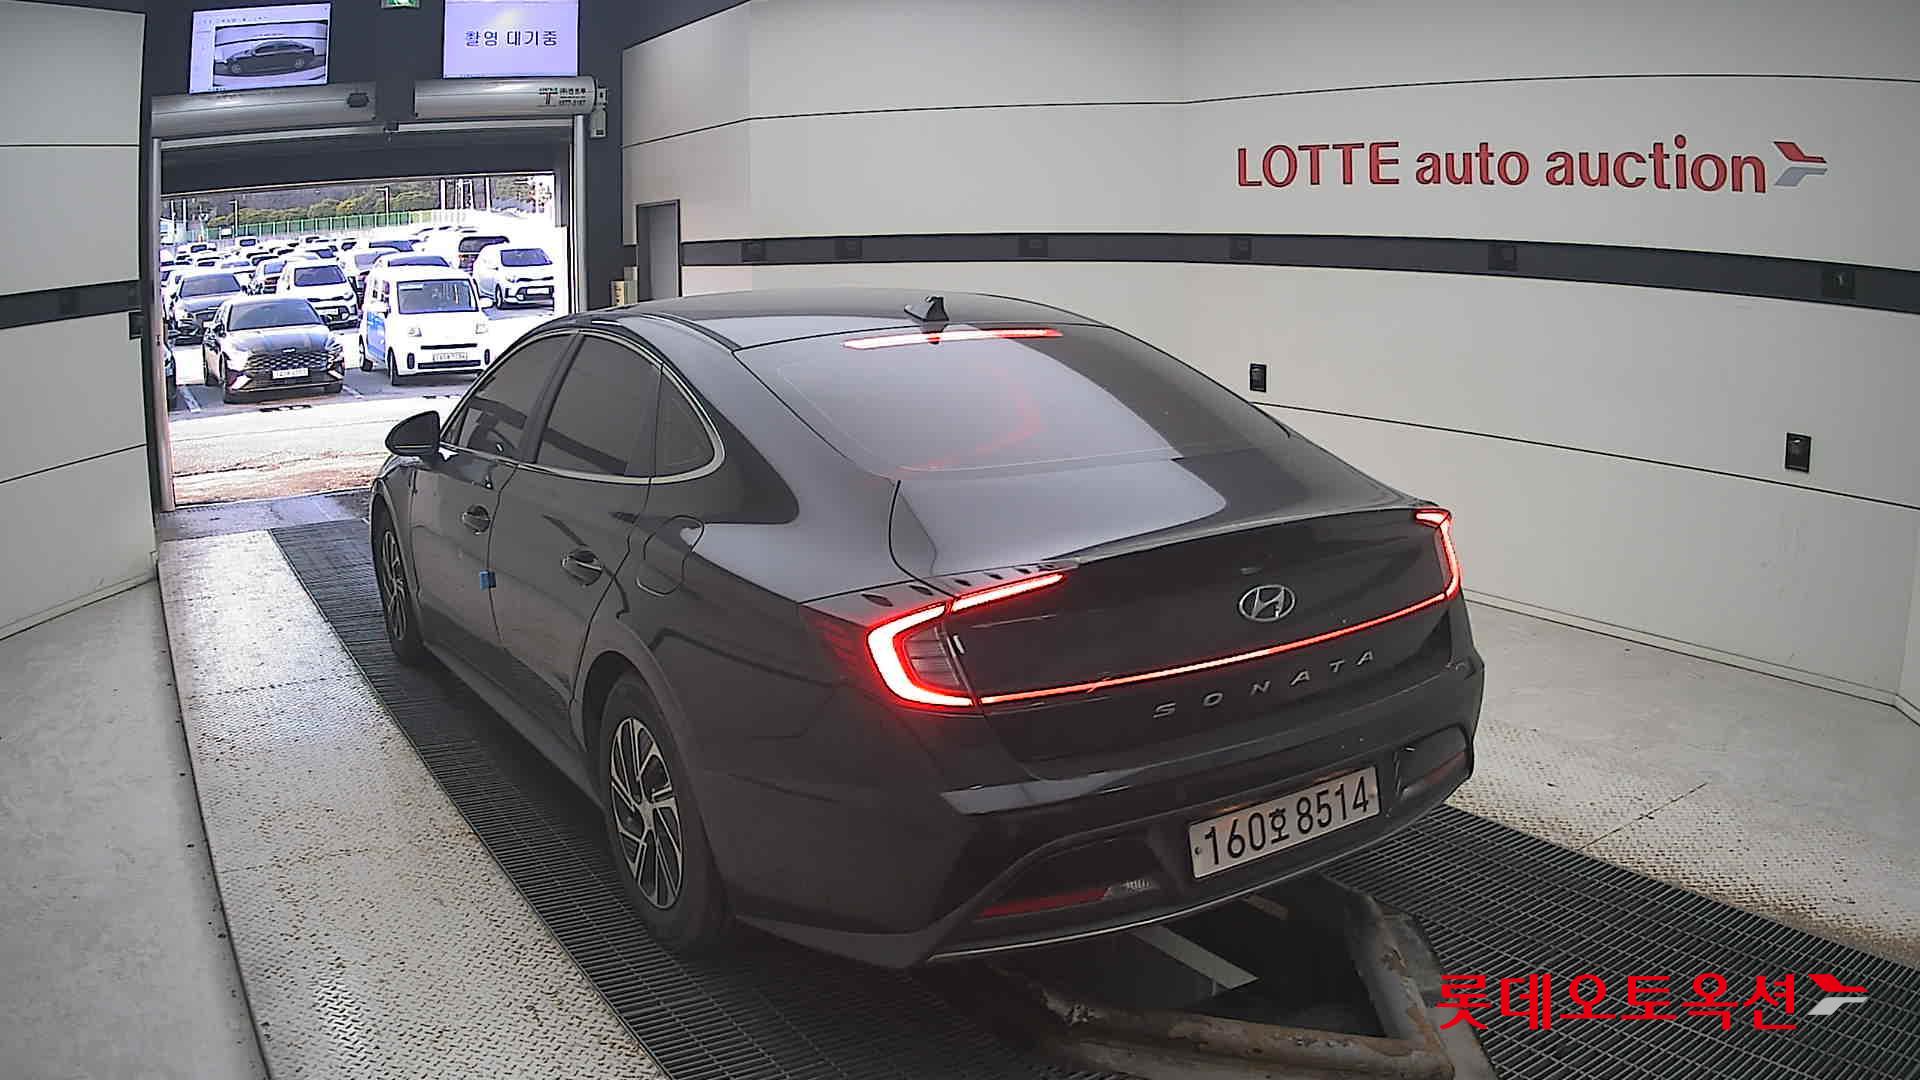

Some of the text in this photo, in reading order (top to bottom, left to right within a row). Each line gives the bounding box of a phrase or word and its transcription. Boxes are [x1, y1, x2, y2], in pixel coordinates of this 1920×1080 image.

[506, 30, 557, 47] 대기중
[1238, 134, 1767, 194] LOTTE auto auction
[1152, 650, 1375, 719] SONATA
[1204, 775, 1369, 865] 160호 8514
